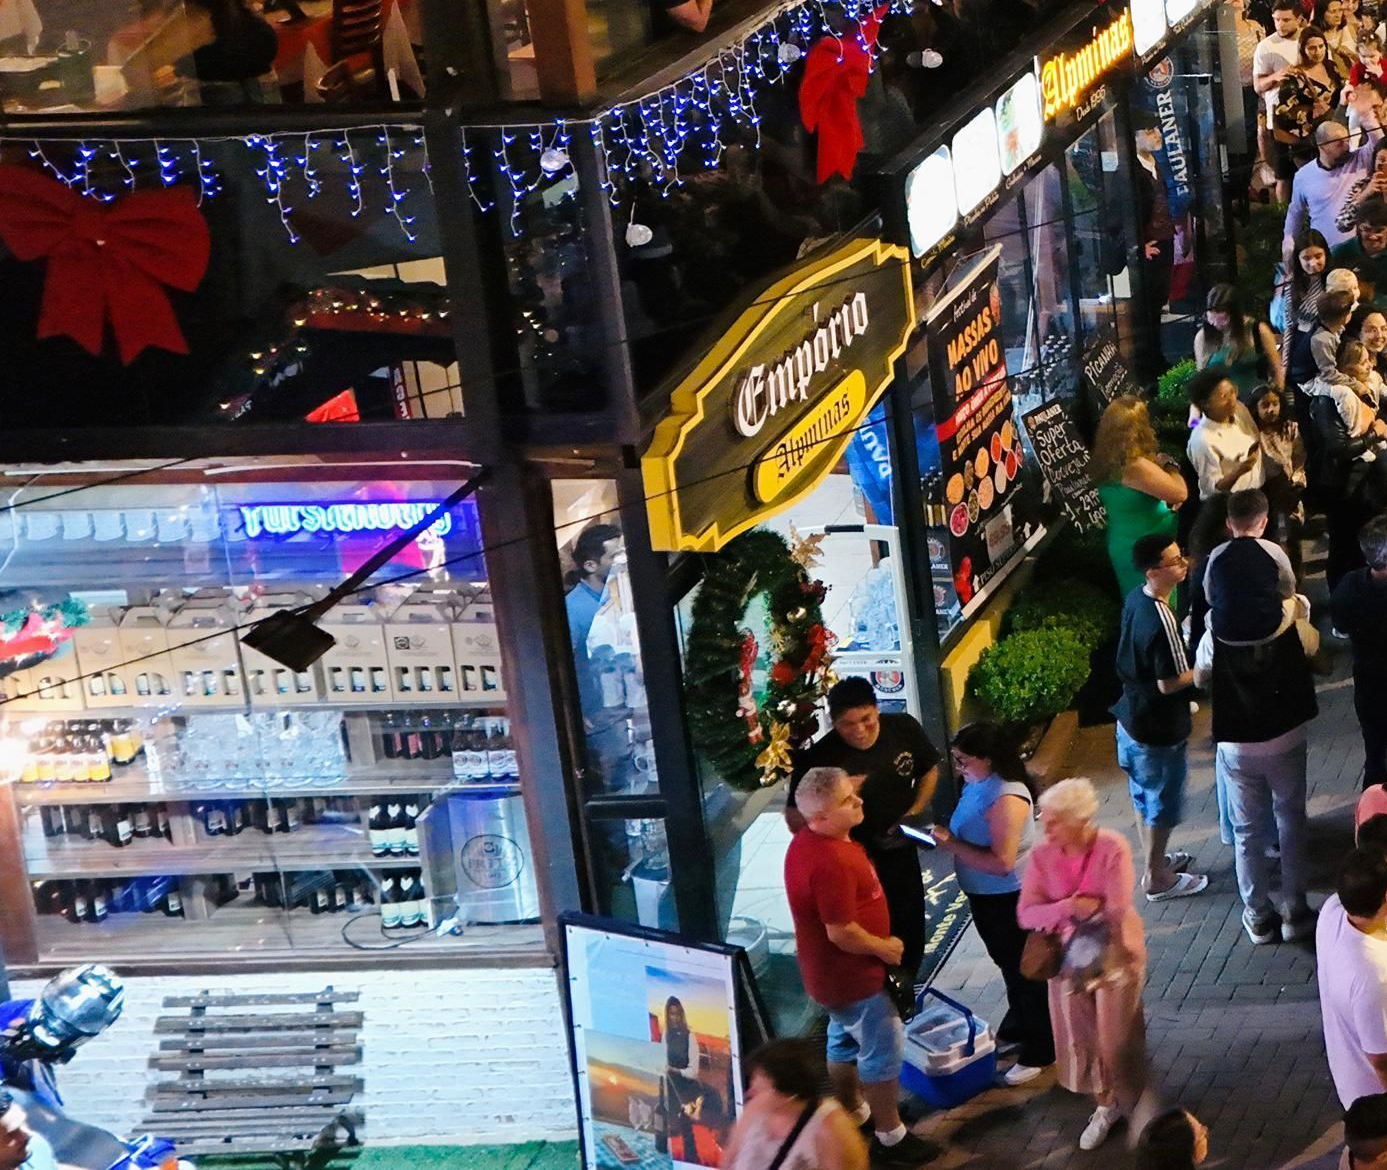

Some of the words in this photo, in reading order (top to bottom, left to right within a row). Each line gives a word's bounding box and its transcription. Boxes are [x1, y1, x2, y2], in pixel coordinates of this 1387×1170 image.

[1042, 7, 1133, 121] Alpminas
[737, 292, 869, 437] Empório
[947, 306, 992, 370] MASSAS
[972, 338, 999, 381] VIVO
[774, 392, 851, 479] Alpminas
[1040, 437, 1085, 466] Oferta
